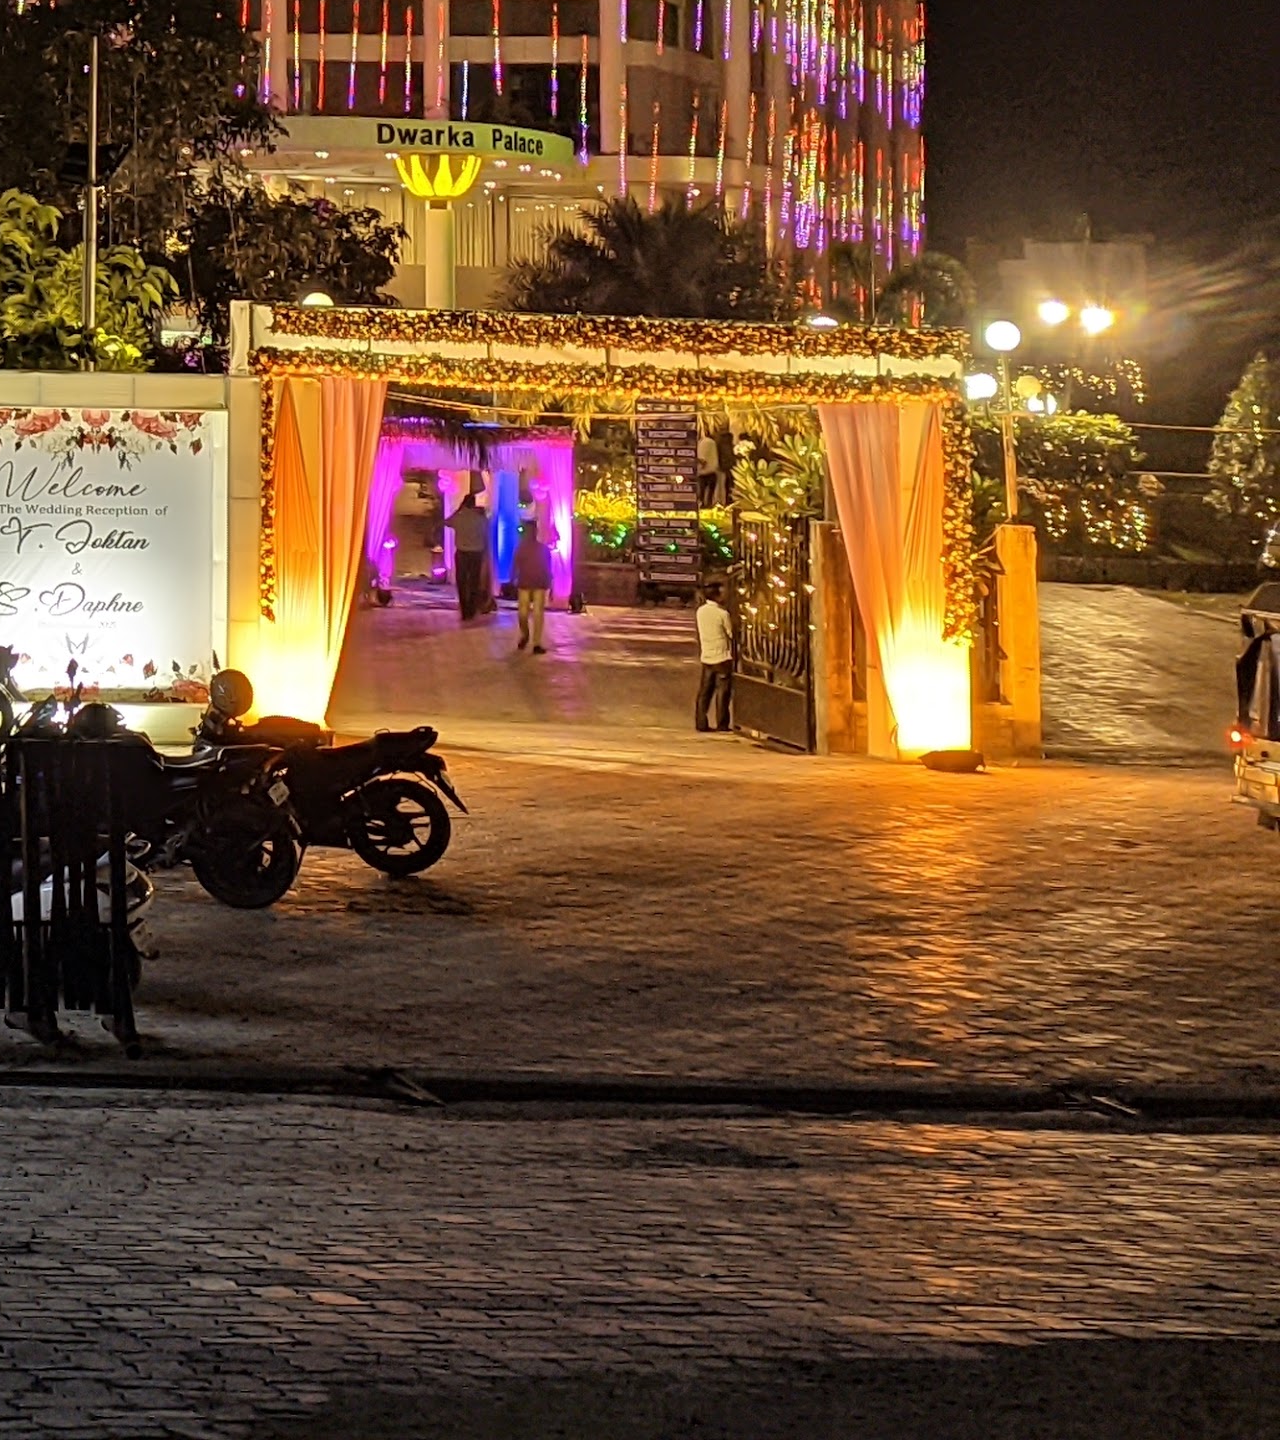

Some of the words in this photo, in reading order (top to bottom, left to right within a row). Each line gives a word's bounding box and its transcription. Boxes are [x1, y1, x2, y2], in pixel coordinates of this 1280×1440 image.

[376, 122, 475, 148] Dwarka
[492, 128, 544, 156] Palace
[25, 504, 83, 517] Wedding
[86, 505, 149, 518] Reception
[155, 506, 168, 516] of
[55, 518, 150, 555] Joktan
[71, 562, 83, 576] &
[39, 582, 144, 619] Daphne
